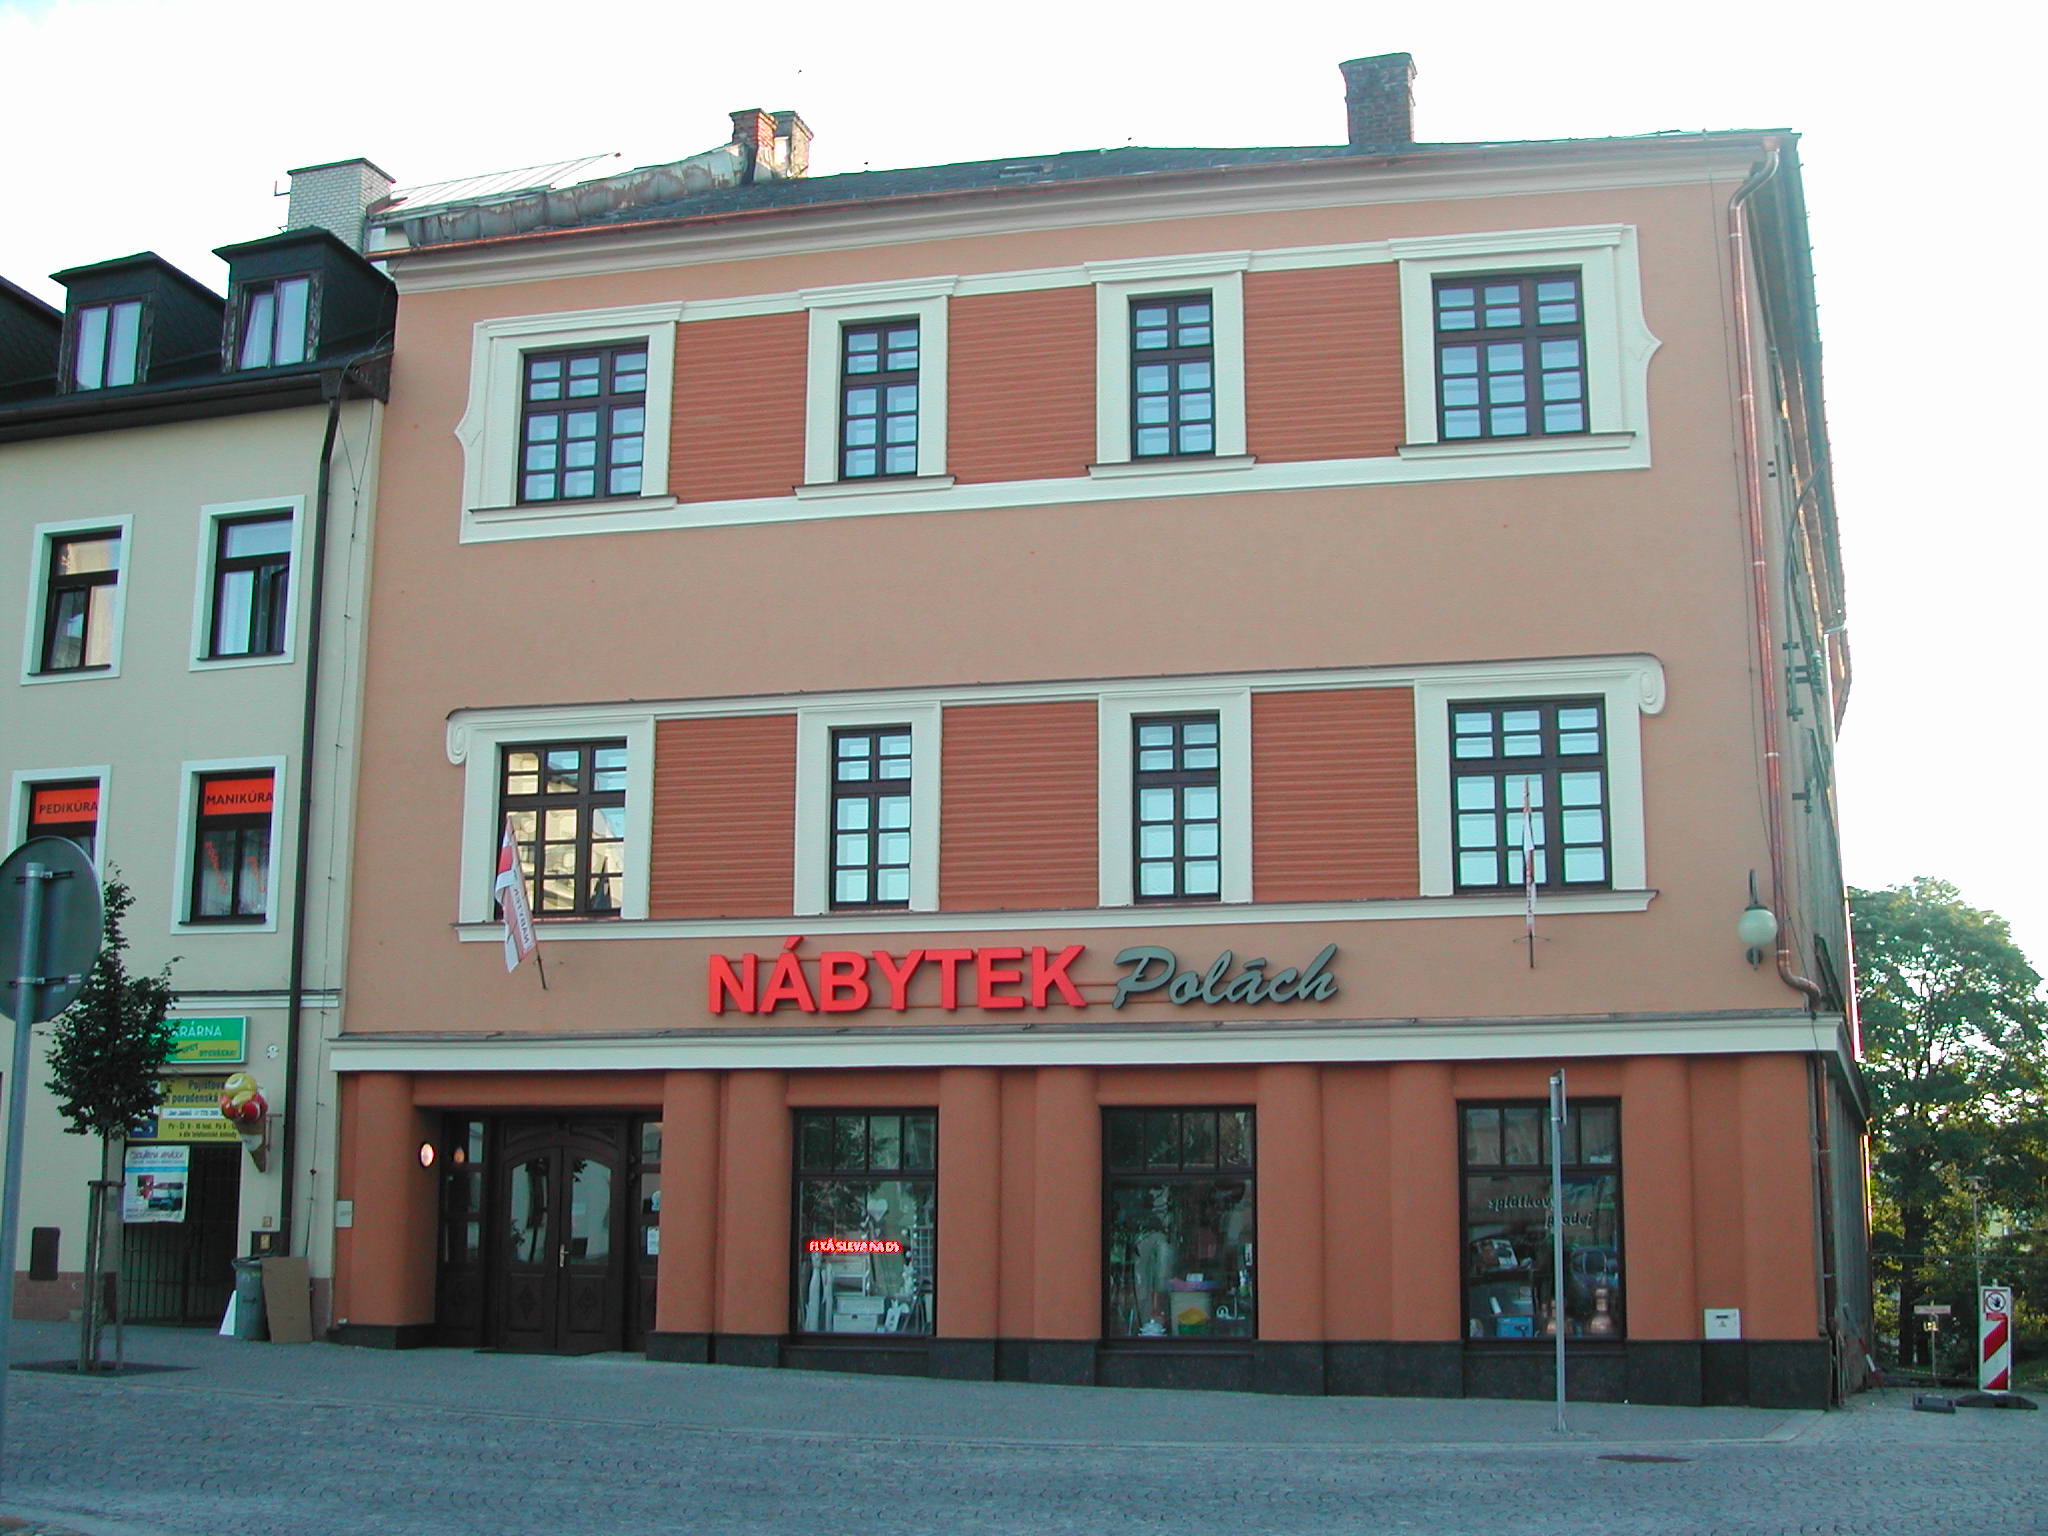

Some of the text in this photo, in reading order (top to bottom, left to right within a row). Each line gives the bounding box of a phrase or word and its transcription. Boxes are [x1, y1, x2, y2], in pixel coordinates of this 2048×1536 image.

[206, 790, 273, 805] MANIKÚRA
[39, 801, 98, 814] PEDIKÚRA
[708, 935, 1339, 1014] NÁBYTEK Polách
[1544, 1211, 1592, 1229] podej
